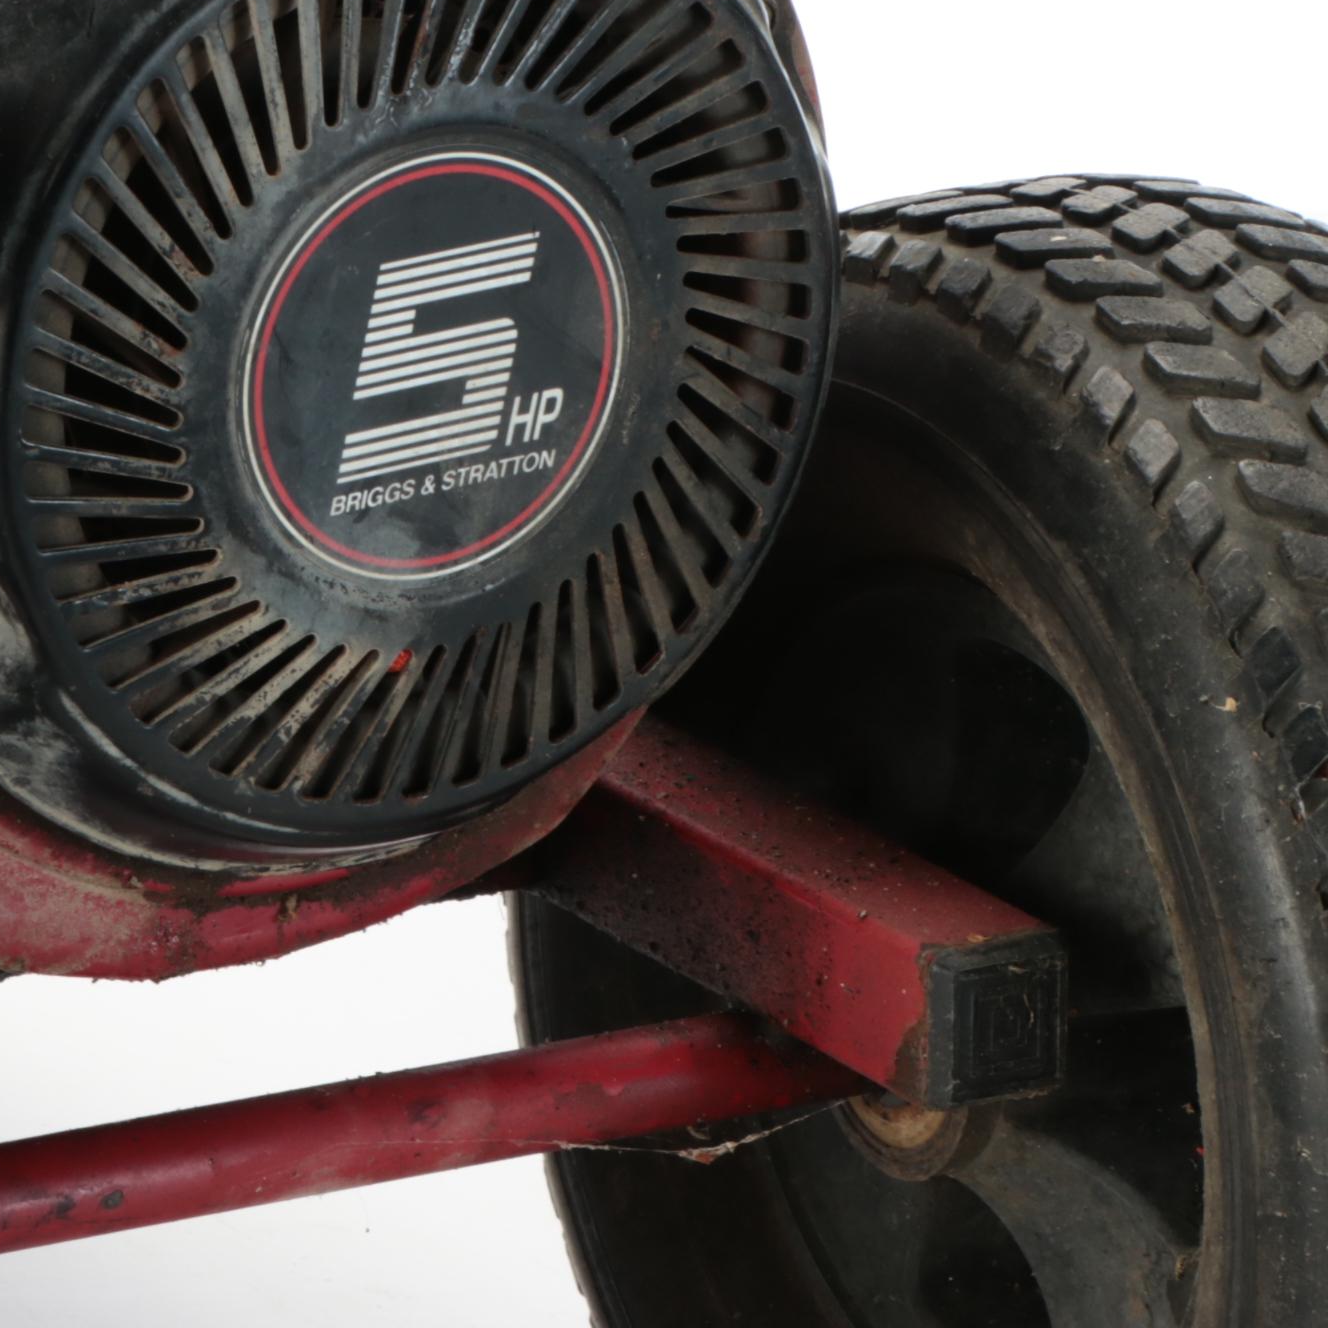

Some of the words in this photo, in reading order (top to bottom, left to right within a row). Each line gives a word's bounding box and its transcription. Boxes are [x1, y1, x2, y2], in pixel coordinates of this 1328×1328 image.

[336, 230, 540, 484] 5
[505, 387, 564, 447] HP
[329, 479, 415, 516] BRIGGS
[421, 474, 435, 496] &
[441, 448, 556, 492] STRATTON
